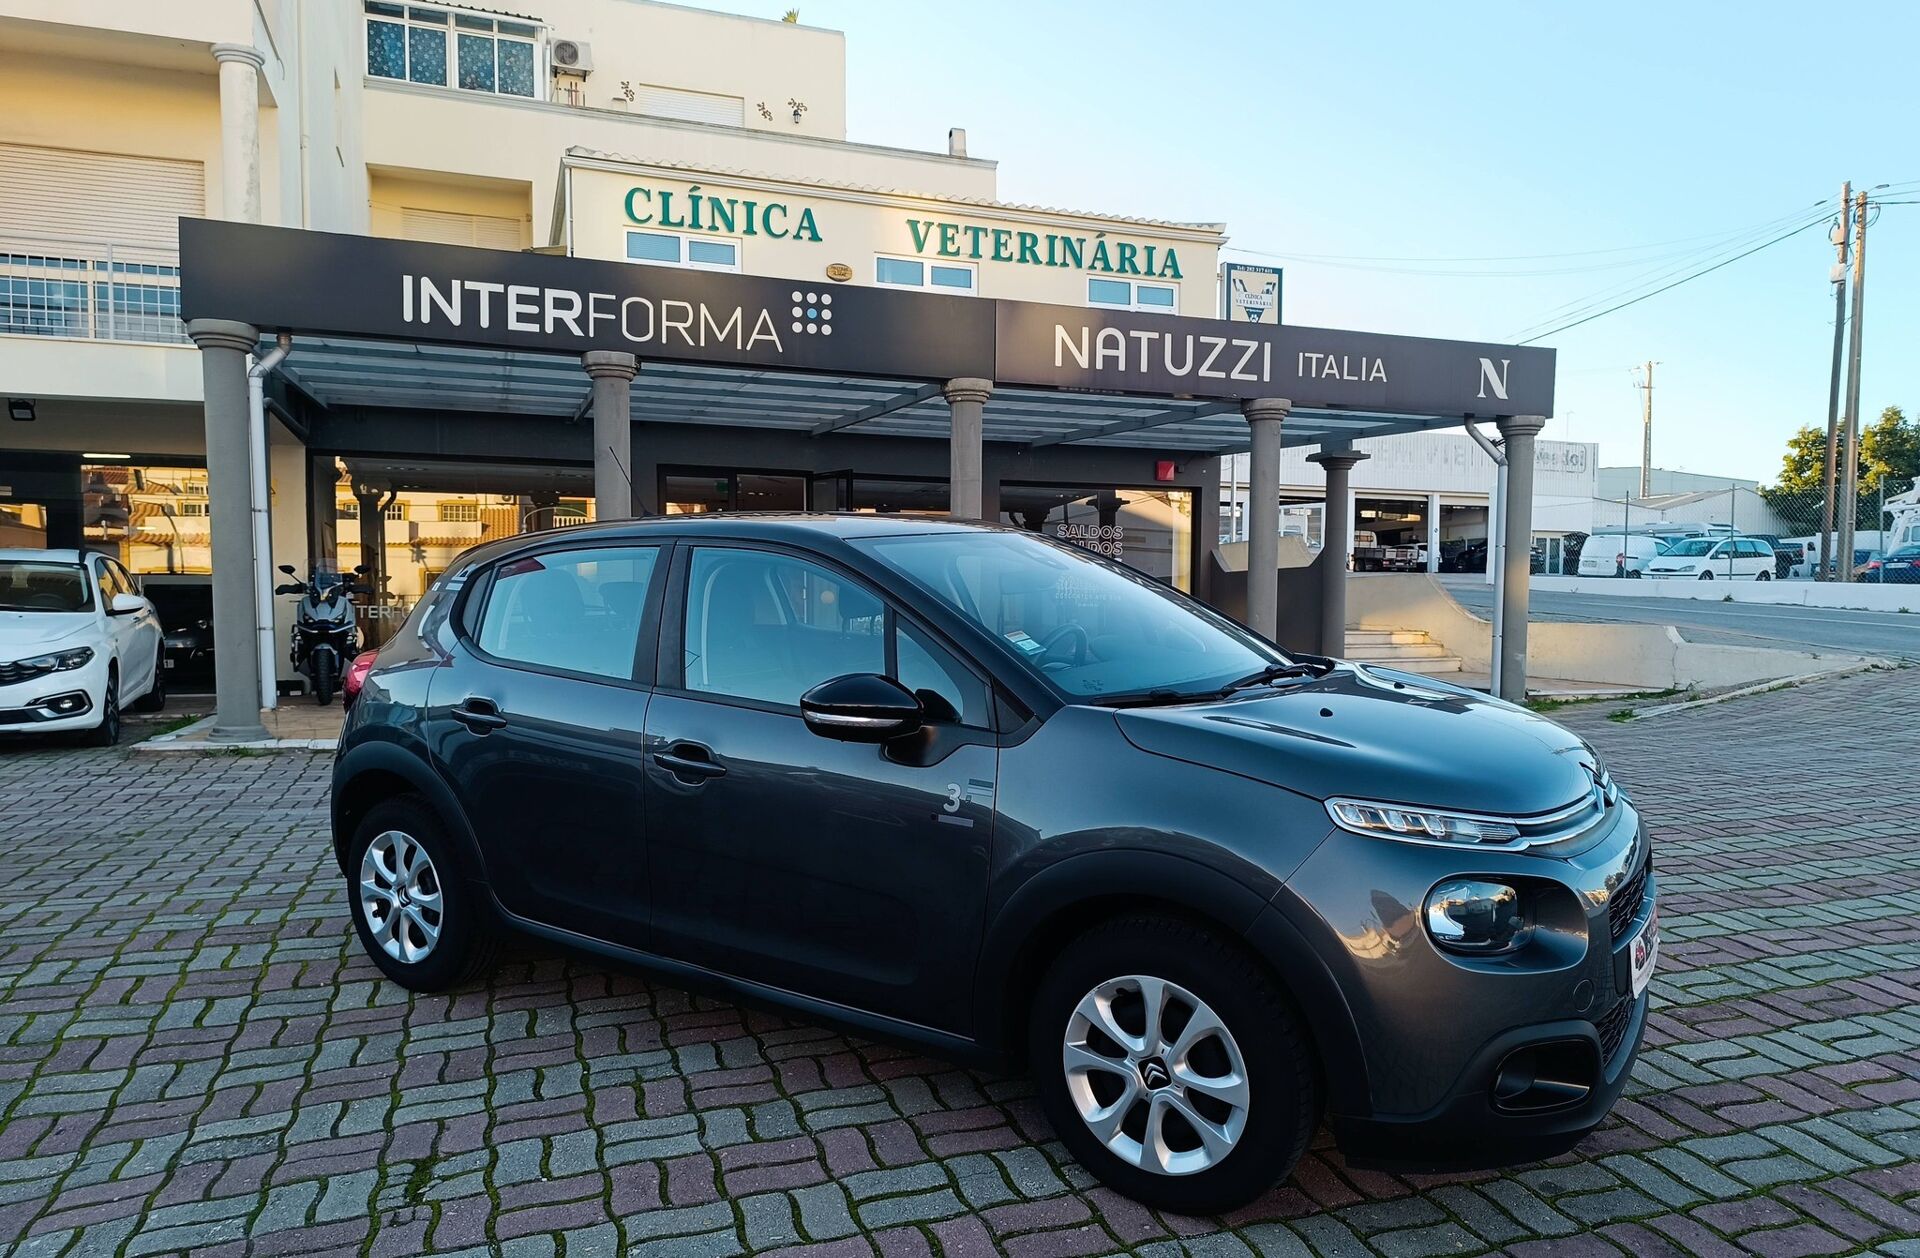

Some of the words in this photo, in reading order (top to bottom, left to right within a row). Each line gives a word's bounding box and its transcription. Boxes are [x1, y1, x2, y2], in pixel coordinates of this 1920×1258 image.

[624, 185, 823, 242] CLÍNICA
[906, 219, 1183, 279] VETERINÁRIA
[402, 275, 783, 353] INTERFORMA
[1054, 324, 1272, 383] NATUZZI
[1297, 352, 1388, 384] ITALIA
[1477, 357, 1511, 400] N
[1057, 523, 1124, 540] SALDOS
[1070, 540, 1123, 556] DOS
[943, 782, 962, 813] 3
